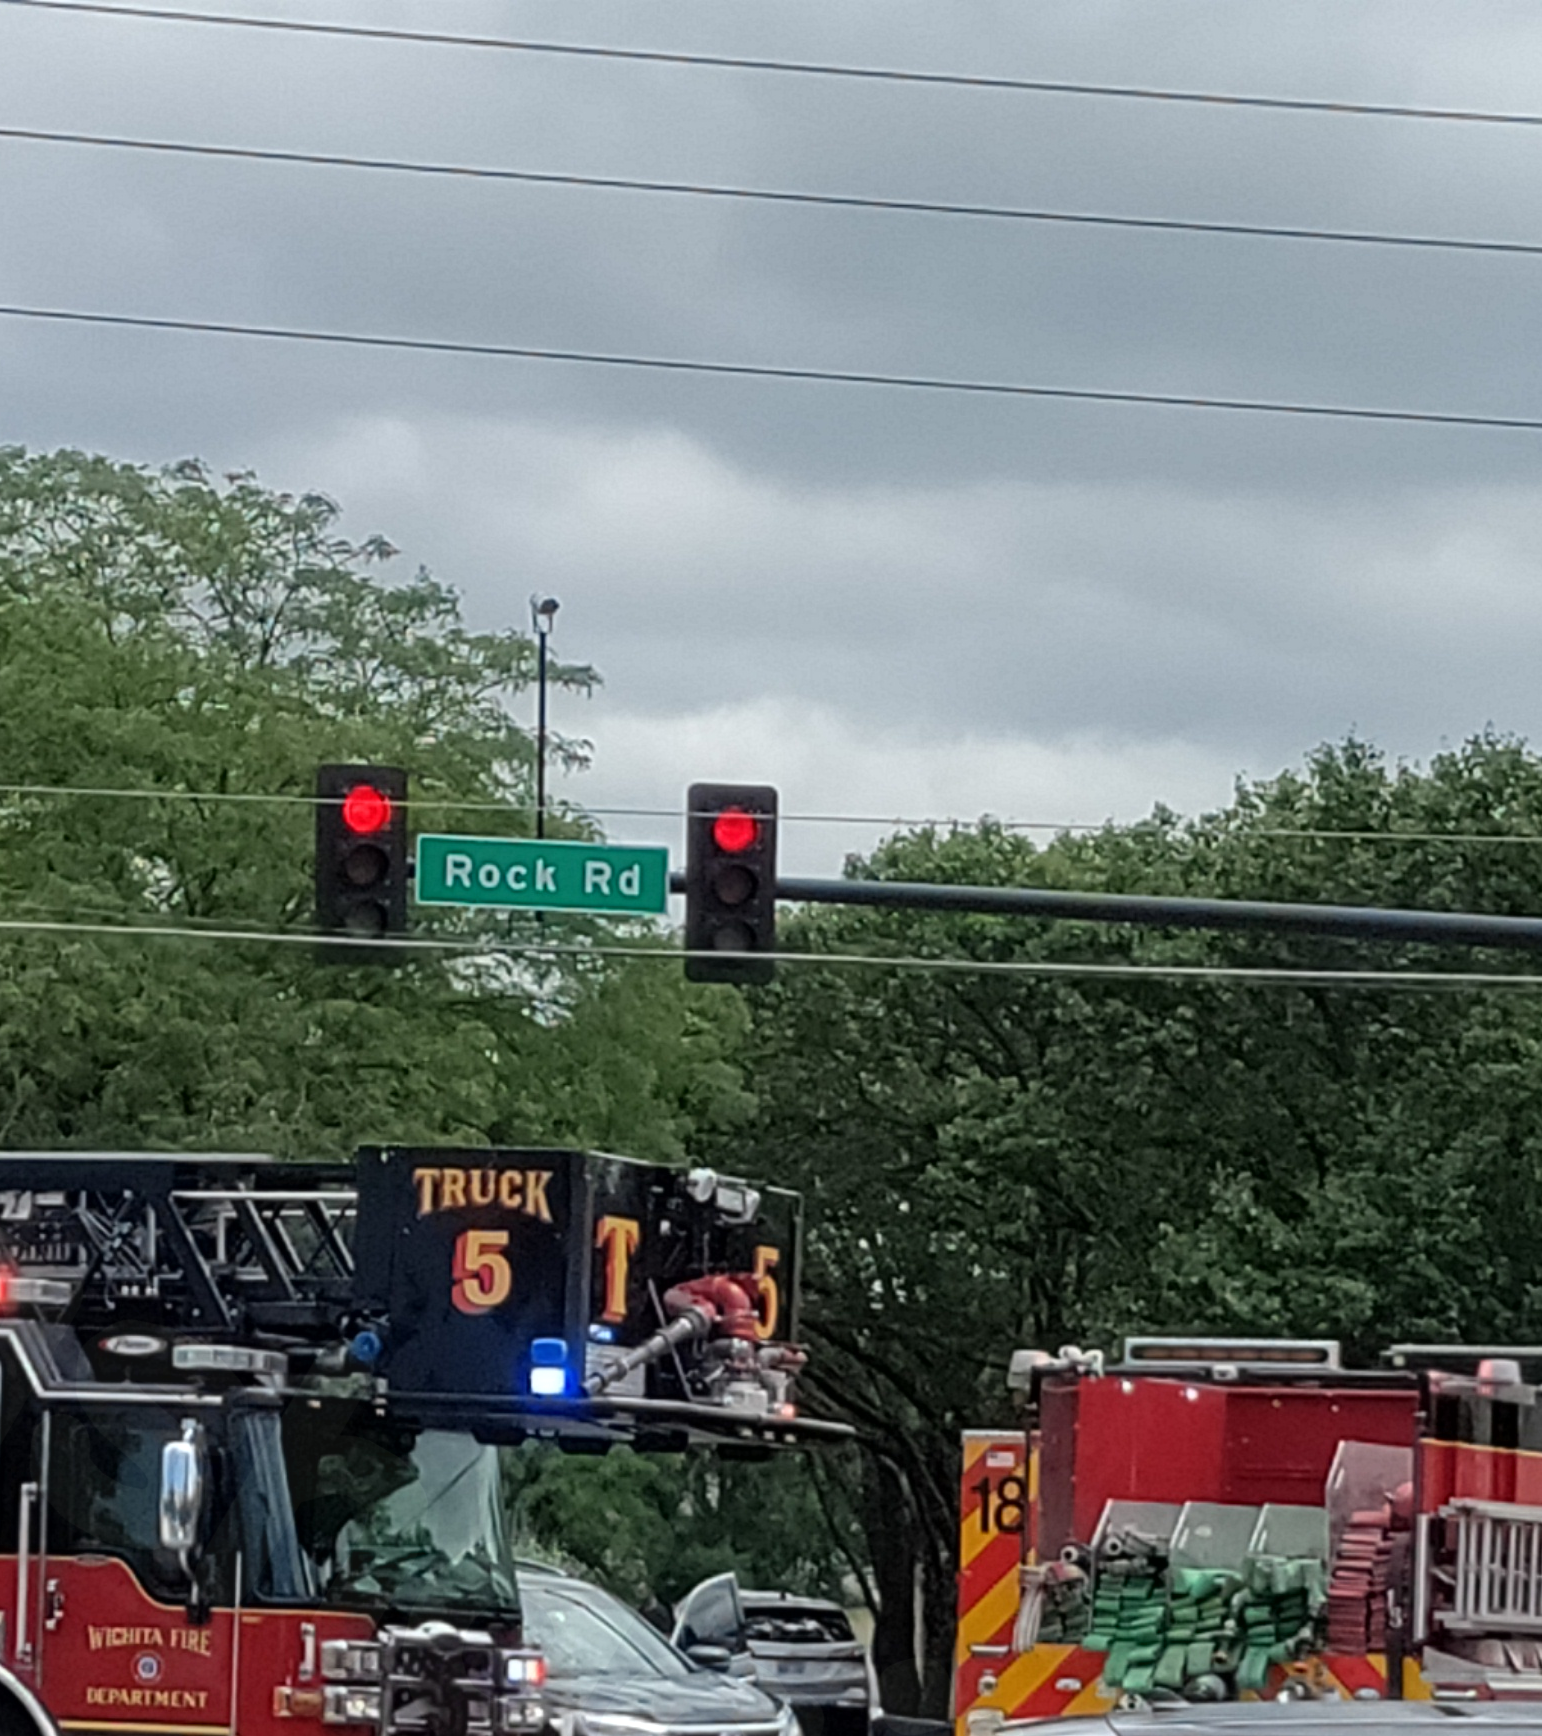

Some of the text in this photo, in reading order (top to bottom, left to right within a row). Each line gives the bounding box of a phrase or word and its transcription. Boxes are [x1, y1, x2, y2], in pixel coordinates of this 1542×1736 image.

[444, 853, 641, 897] Rock Rd
[411, 1167, 556, 1224] TRUCK
[451, 1229, 512, 1316] 5
[595, 1216, 640, 1324] T
[970, 1476, 1026, 1534] 18
[87, 1624, 212, 1657] WICHITA FIRE
[86, 1686, 208, 1709] DEPARTMENT
